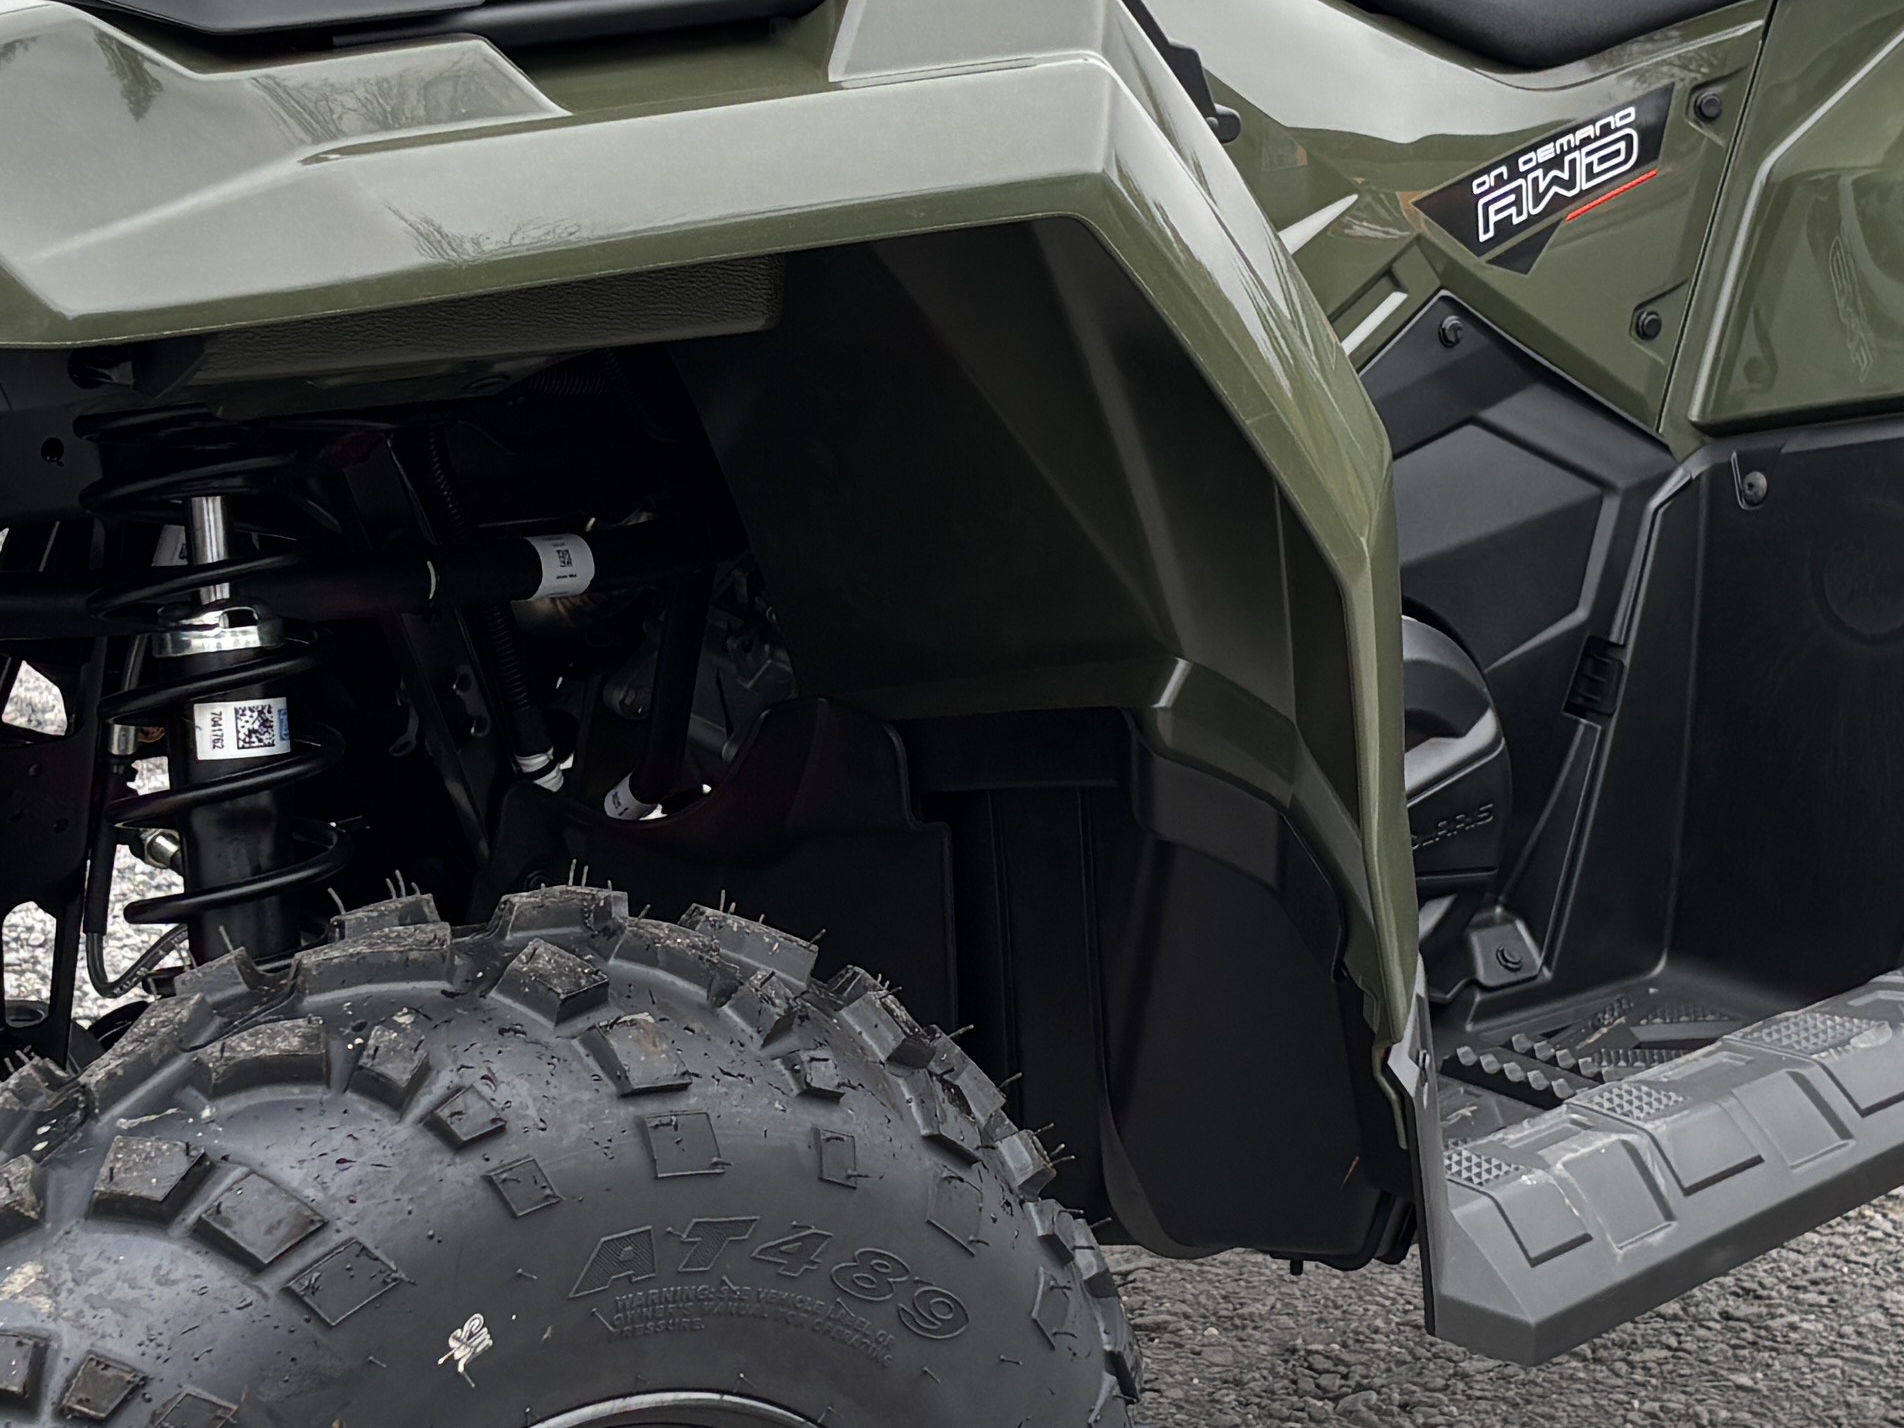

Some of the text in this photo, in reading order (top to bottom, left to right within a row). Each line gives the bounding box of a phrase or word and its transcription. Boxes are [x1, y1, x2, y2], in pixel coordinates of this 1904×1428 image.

[1471, 106, 1636, 196] ON DEMAND
[1477, 126, 1639, 243] AWD
[209, 710, 225, 751] 7041762
[1411, 802, 1494, 850] LARIS
[568, 1216, 970, 1340] AT489
